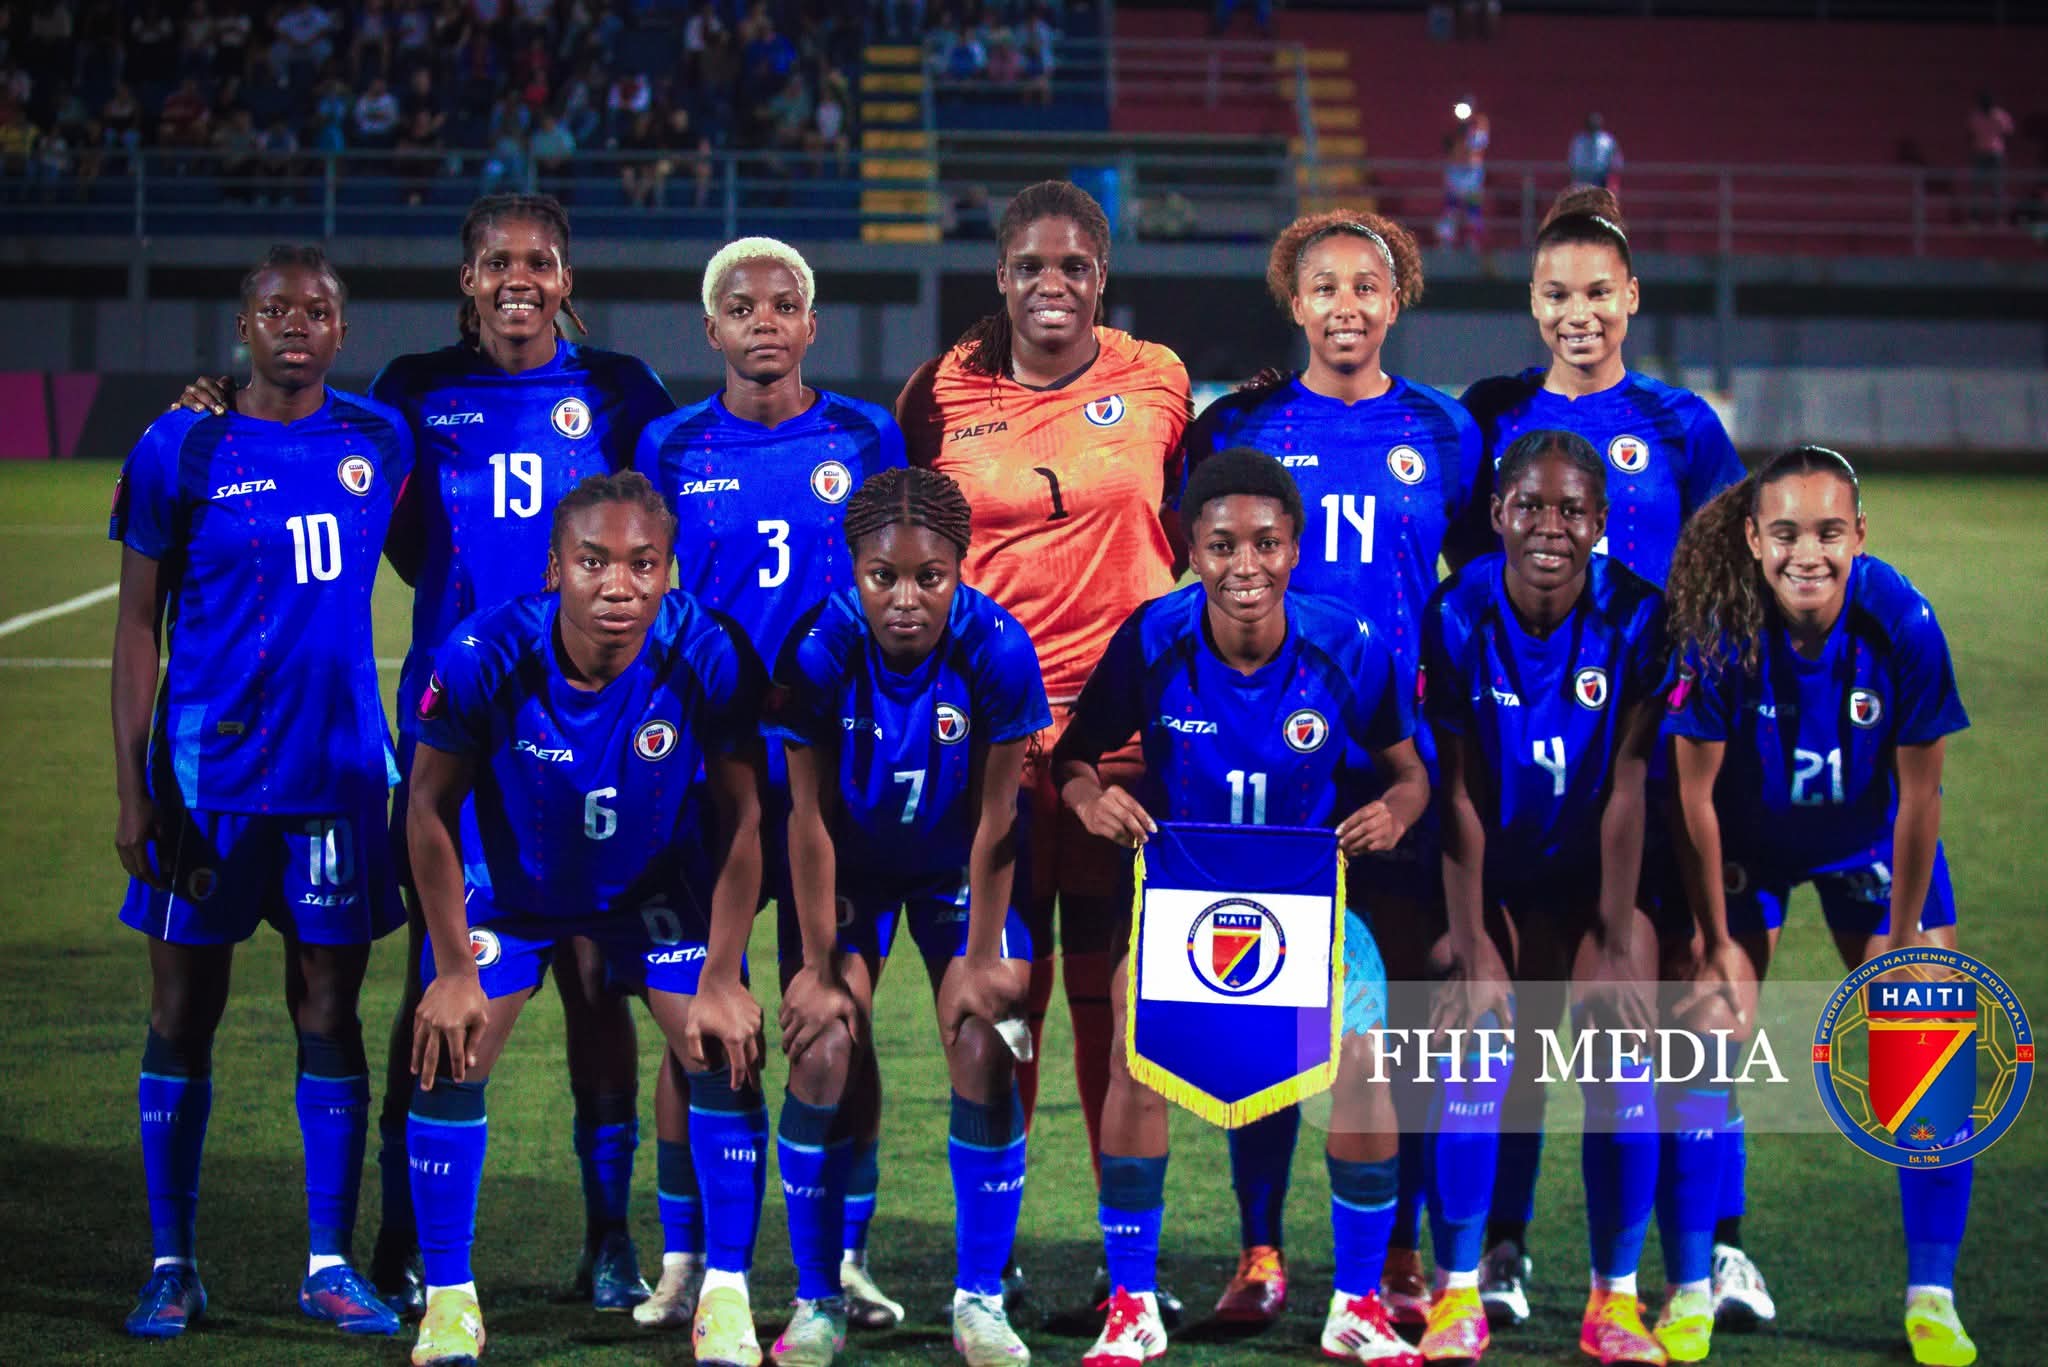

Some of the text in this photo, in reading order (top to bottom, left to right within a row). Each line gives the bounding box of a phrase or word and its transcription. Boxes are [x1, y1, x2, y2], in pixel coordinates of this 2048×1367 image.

[424, 412, 485, 428] SAETA
[949, 420, 1009, 442] SAETA
[211, 478, 277, 500] SAETA
[488, 452, 543, 519] 19
[679, 478, 741, 496] SAETA
[1274, 454, 1320, 468] ETA
[1033, 466, 1070, 522] 1
[285, 512, 343, 585] 10
[757, 519, 791, 589] 3
[1320, 493, 1376, 564] 14
[512, 739, 575, 763] SAETA
[1152, 714, 1219, 735] SAETA
[1532, 735, 1567, 797] 4
[1790, 747, 1846, 806] 21
[583, 785, 618, 841] 6
[893, 768, 927, 824] 7
[1225, 769, 1268, 825] 11
[304, 819, 355, 887] 10
[1217, 914, 1258, 926] HAITI
